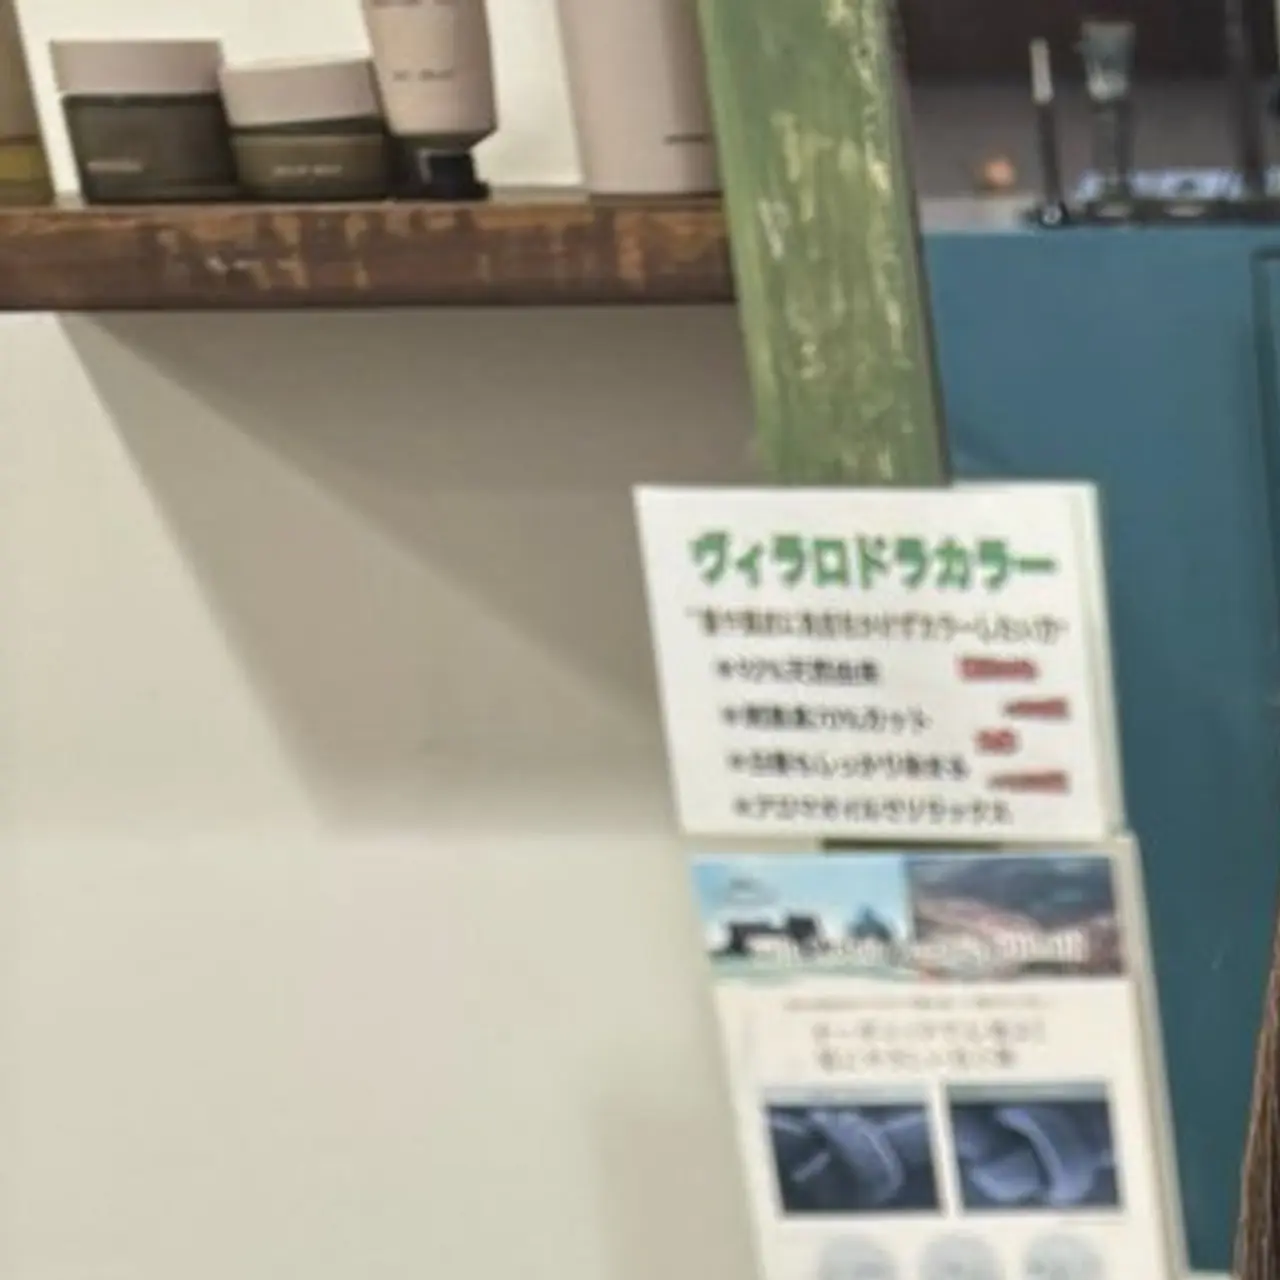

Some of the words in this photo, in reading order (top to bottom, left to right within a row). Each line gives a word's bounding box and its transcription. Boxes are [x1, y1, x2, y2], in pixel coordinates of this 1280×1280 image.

[688, 530, 1057, 590] ヴィラロドラカラー
